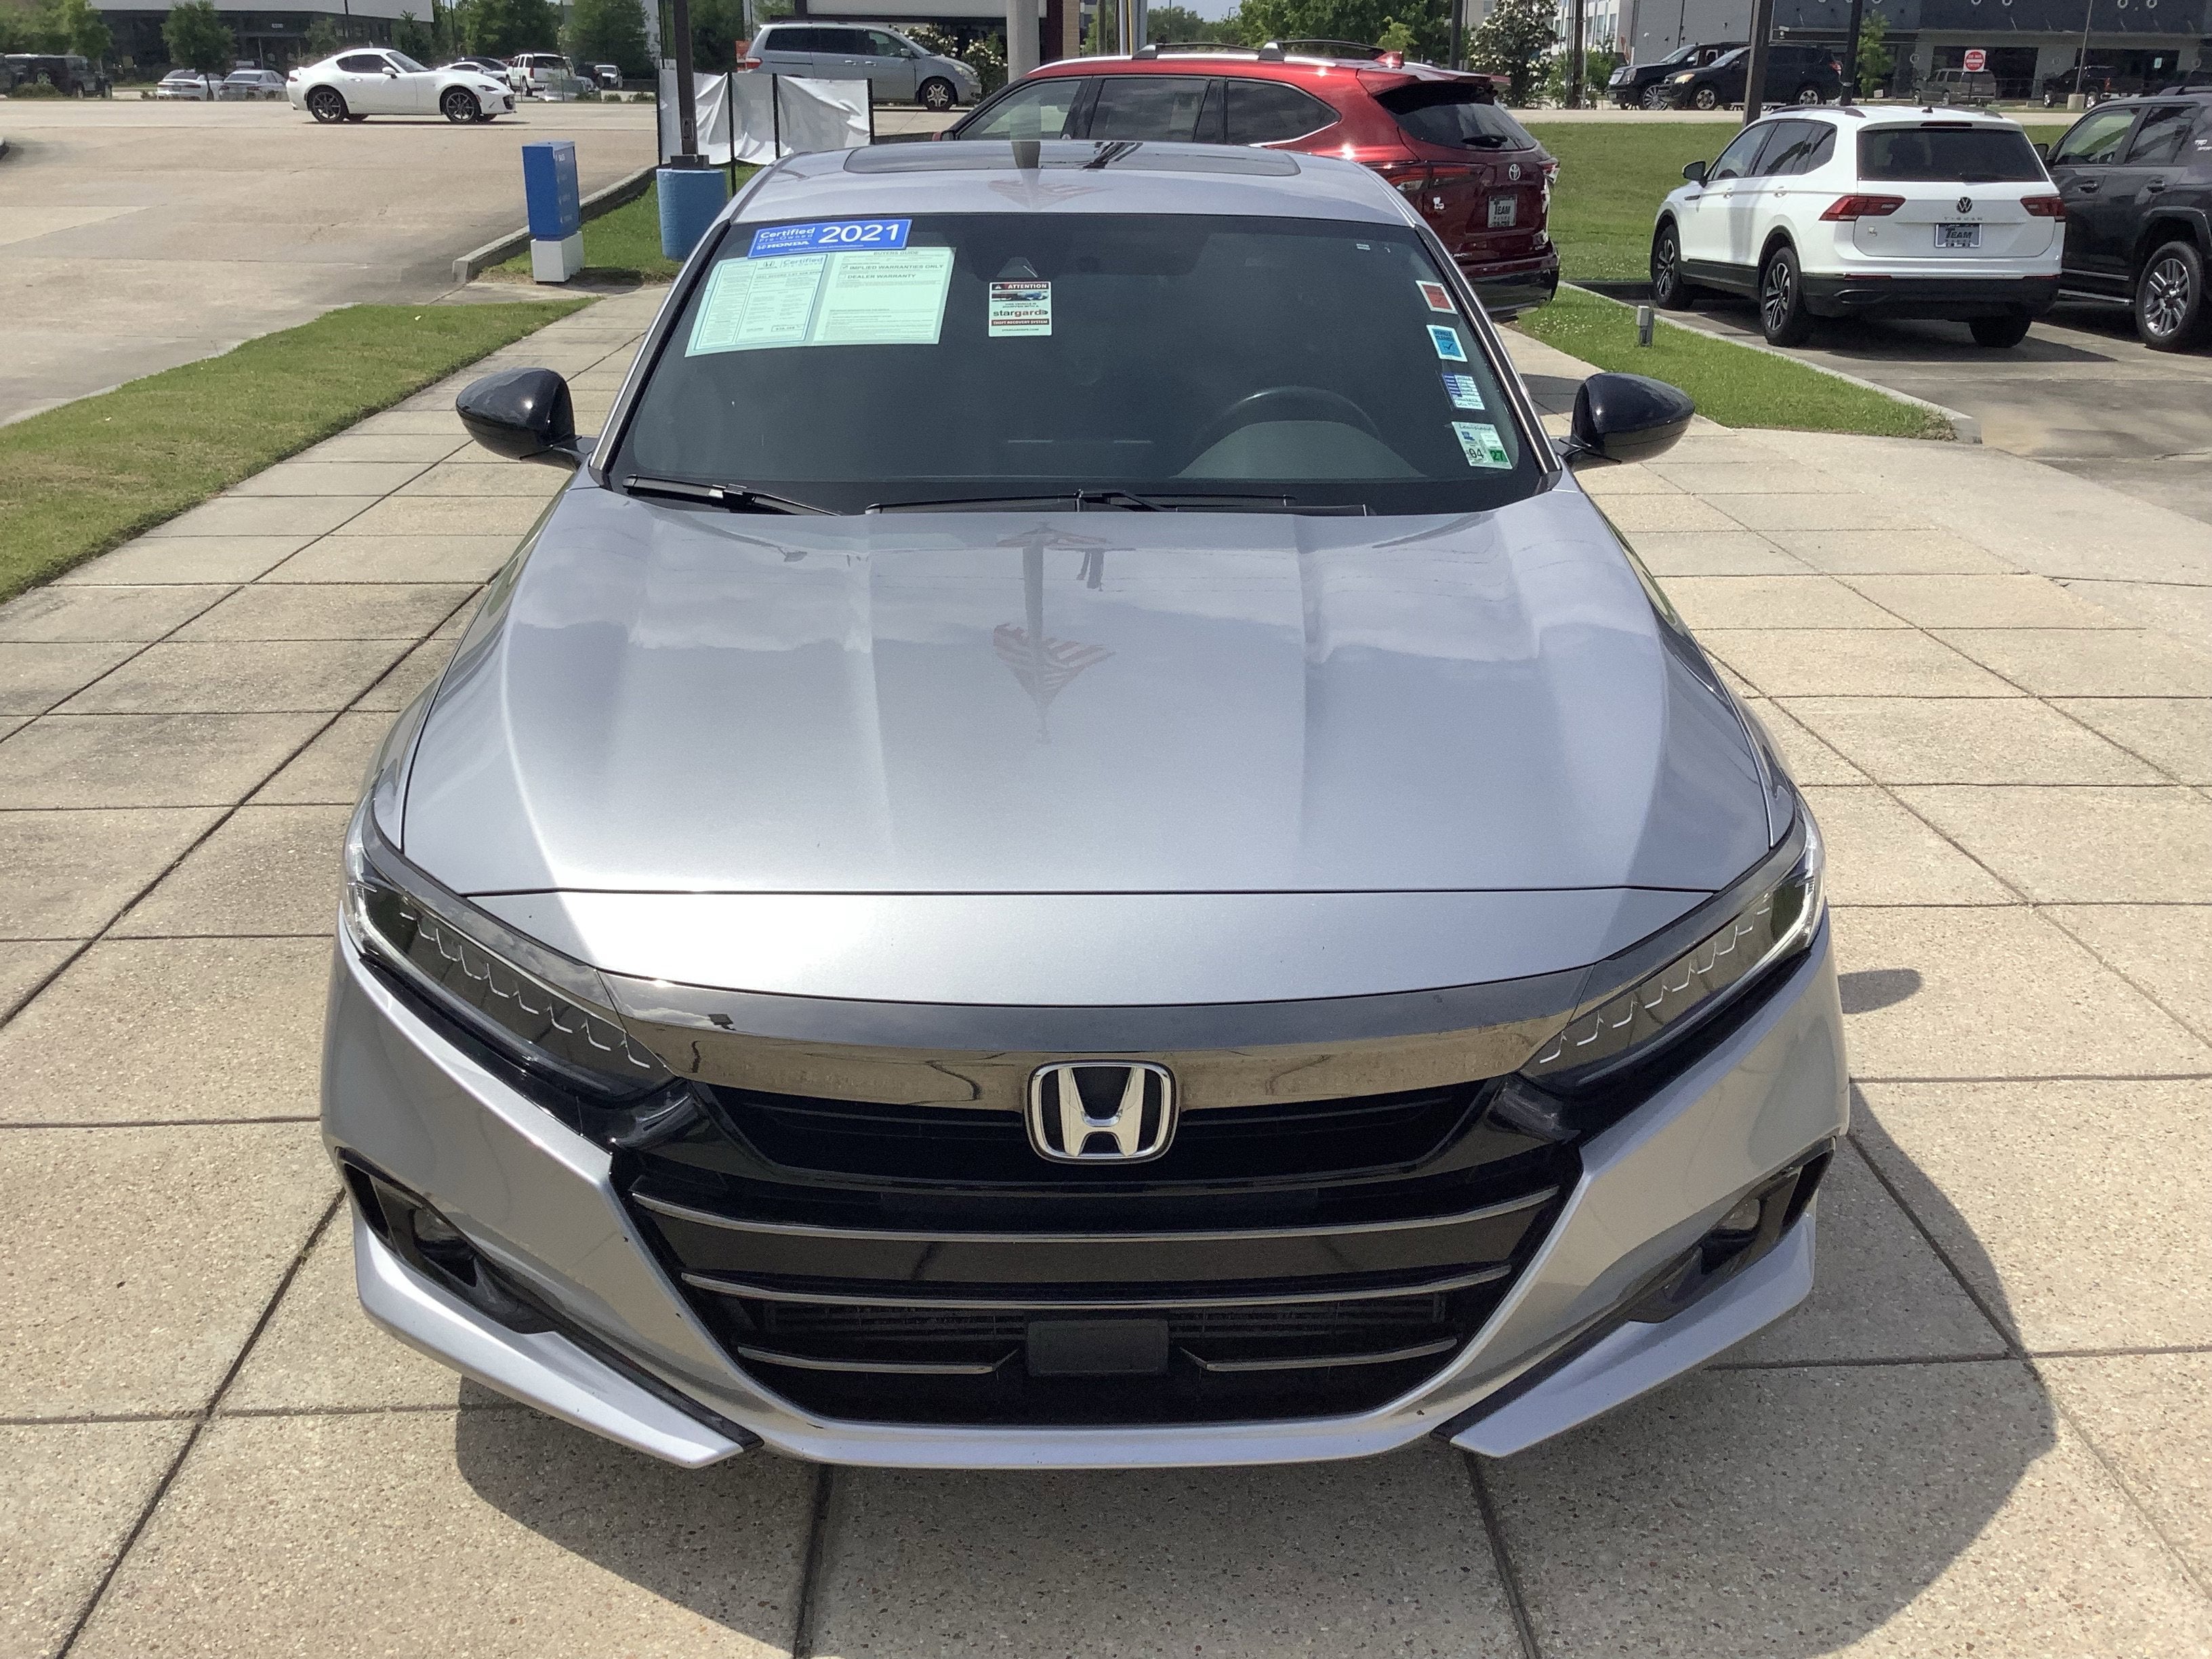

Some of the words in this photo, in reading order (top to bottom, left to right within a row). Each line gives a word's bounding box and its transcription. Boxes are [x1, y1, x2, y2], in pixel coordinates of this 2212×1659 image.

[760, 227, 815, 239] Certified
[817, 224, 900, 244] 2021
[1945, 226, 1973, 239] TEAM
[766, 241, 810, 250] HONDA
[993, 309, 1042, 317] stargard
[1469, 448, 1484, 459] 04
[1490, 449, 1504, 461] 27
